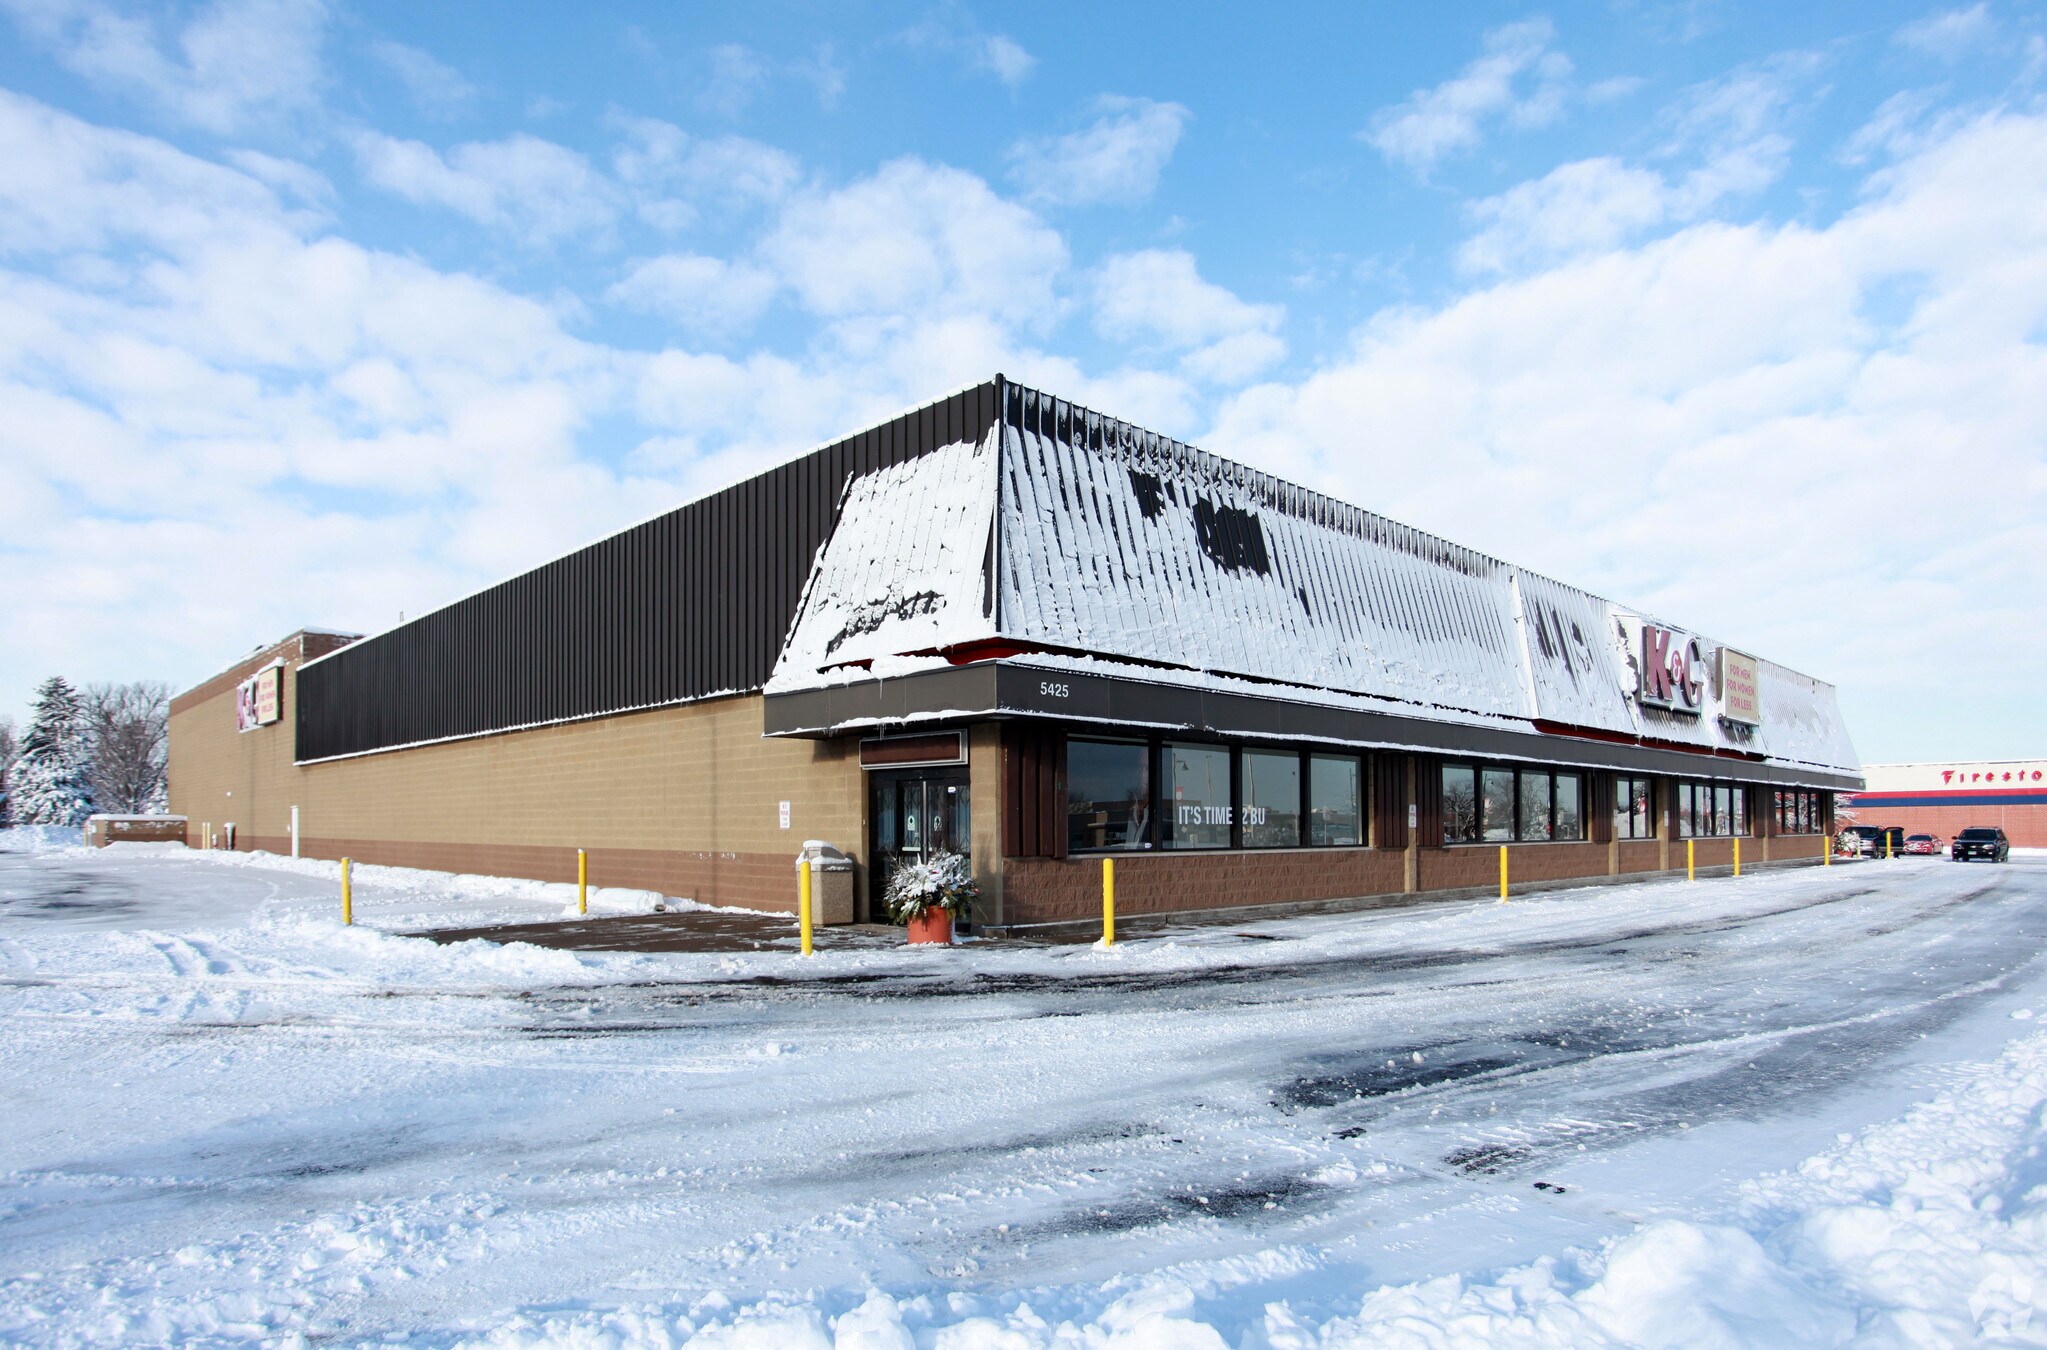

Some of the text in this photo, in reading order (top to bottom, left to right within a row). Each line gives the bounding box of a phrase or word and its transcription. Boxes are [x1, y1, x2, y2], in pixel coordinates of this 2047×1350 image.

[1729, 663, 1739, 677] FOR
[1040, 681, 1069, 698] 5425
[1726, 678, 1737, 692] FOR
[1730, 695, 1740, 709] FOR
[1941, 769, 2043, 786] Firesto
[1178, 805, 1265, 826] IT'S TIME 2 BU
